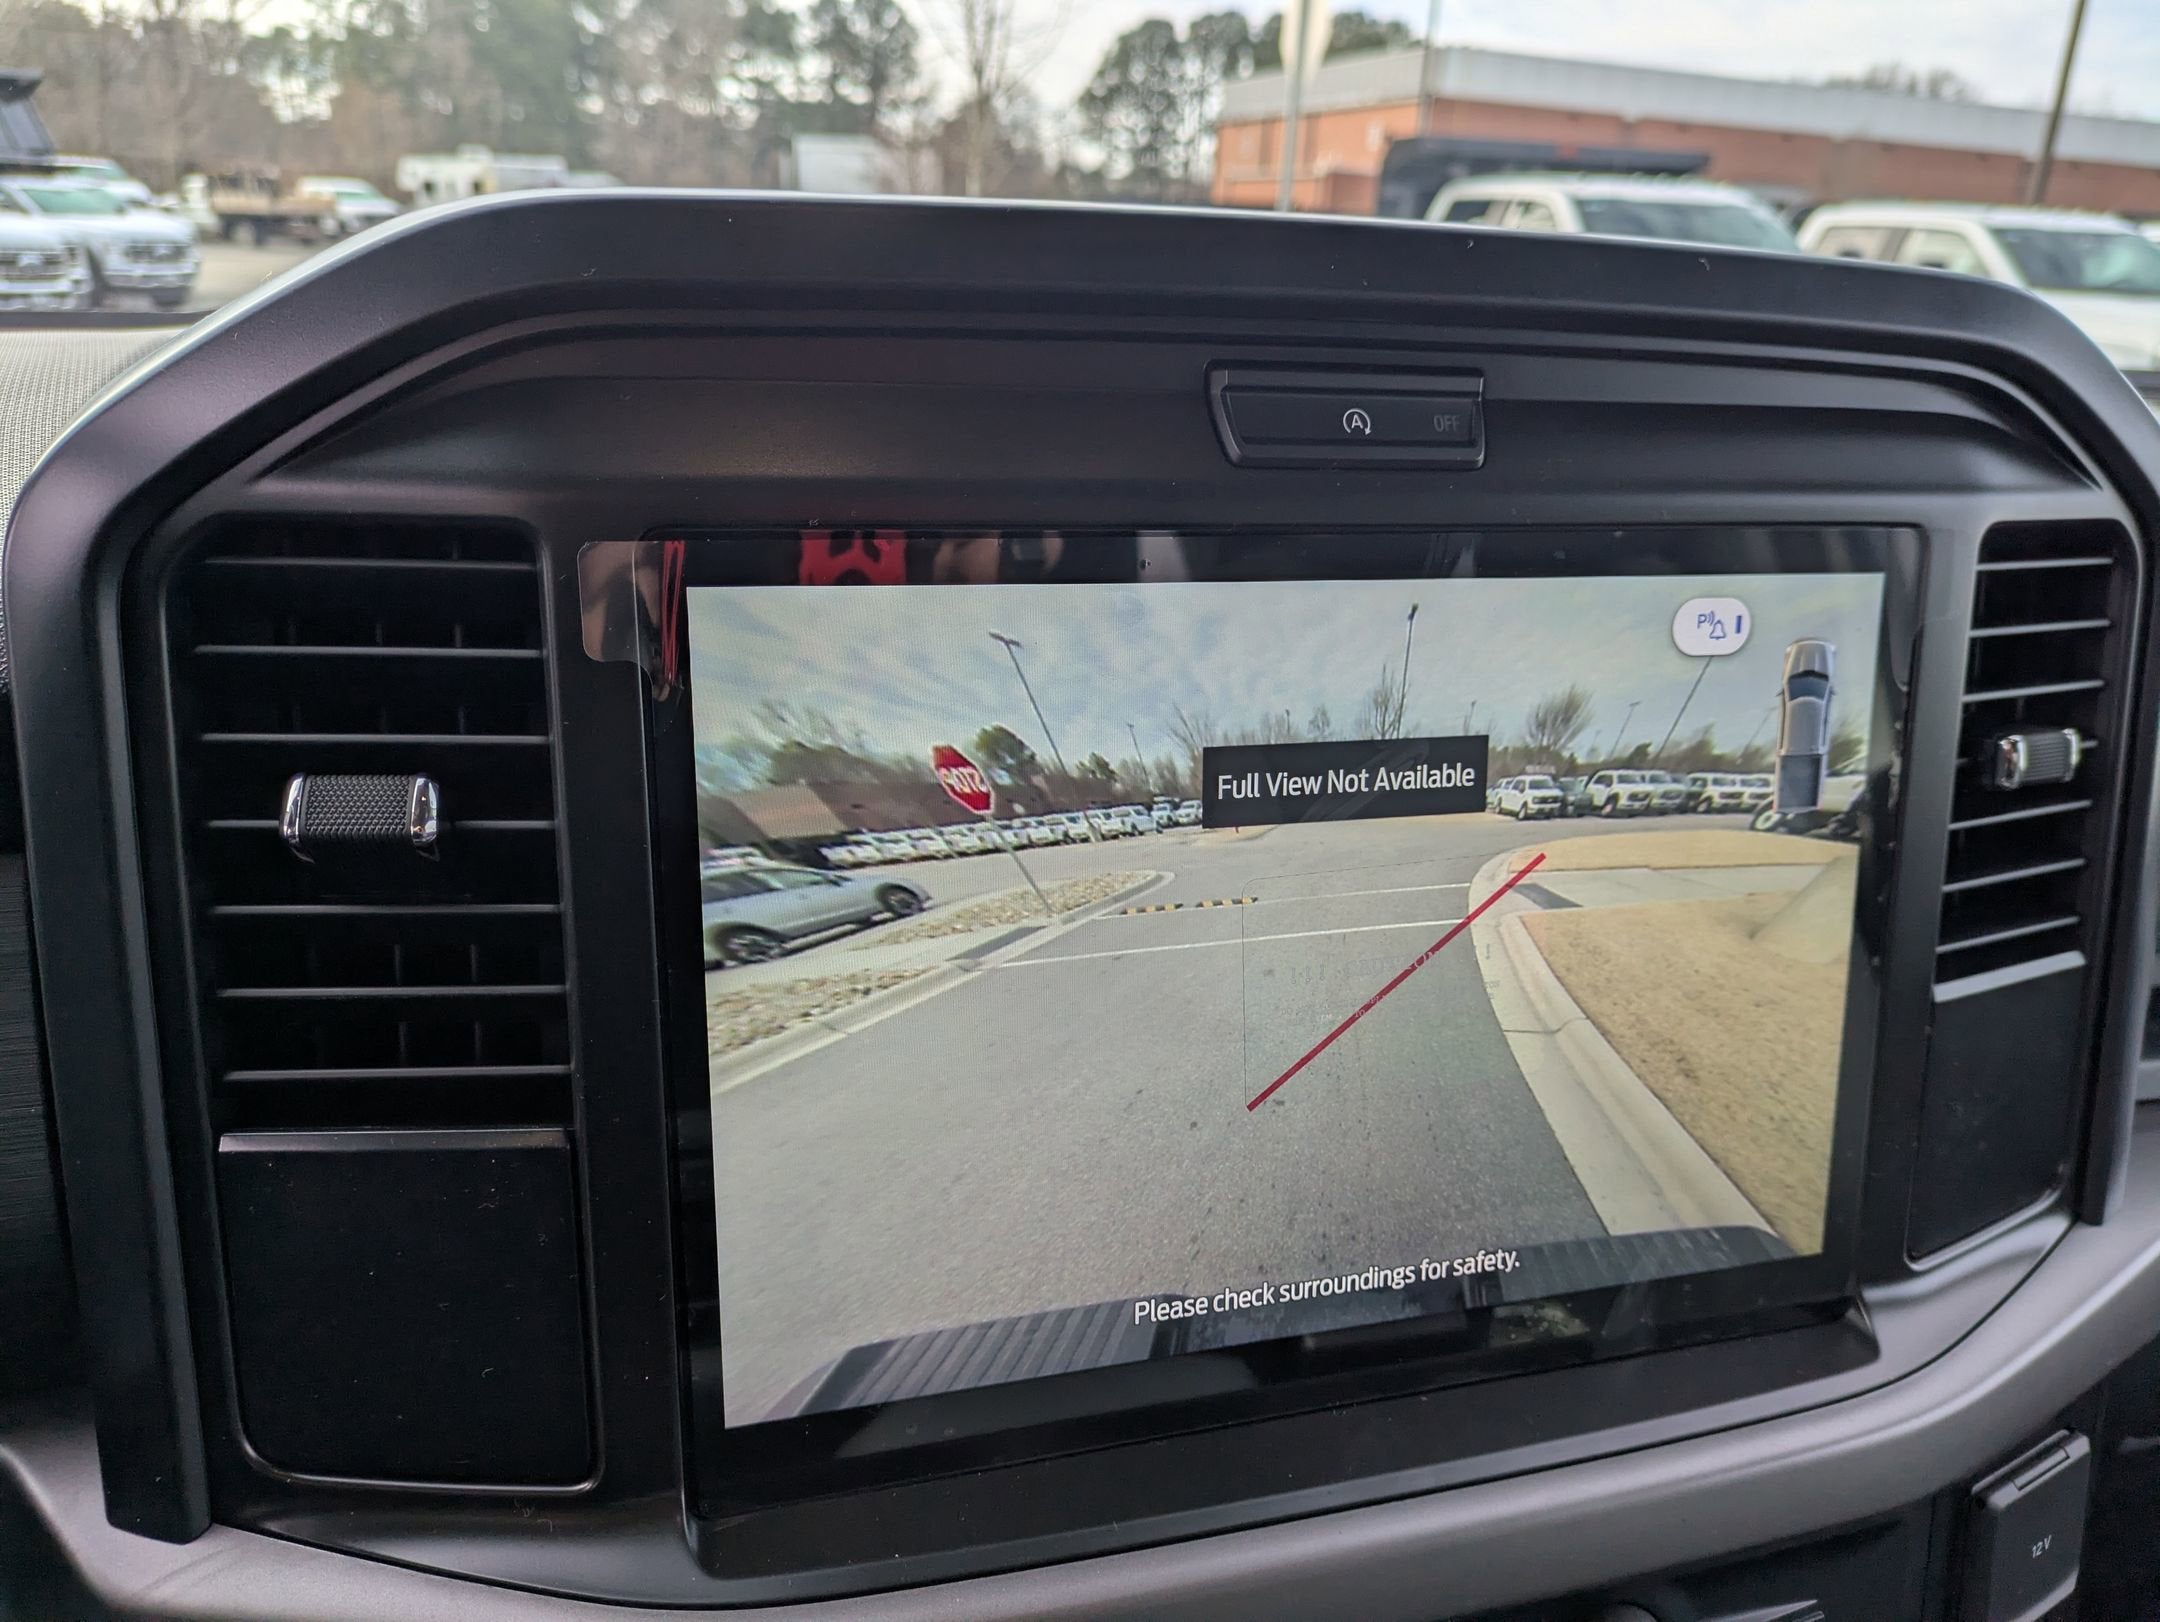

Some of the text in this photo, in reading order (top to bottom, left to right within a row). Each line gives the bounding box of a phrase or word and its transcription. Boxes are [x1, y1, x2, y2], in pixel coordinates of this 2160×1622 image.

[1433, 415, 1461, 432] OFF
[1217, 763, 1475, 800] Full View Not Available
[1134, 1249, 1520, 1325] Please check surroundings for safety.
